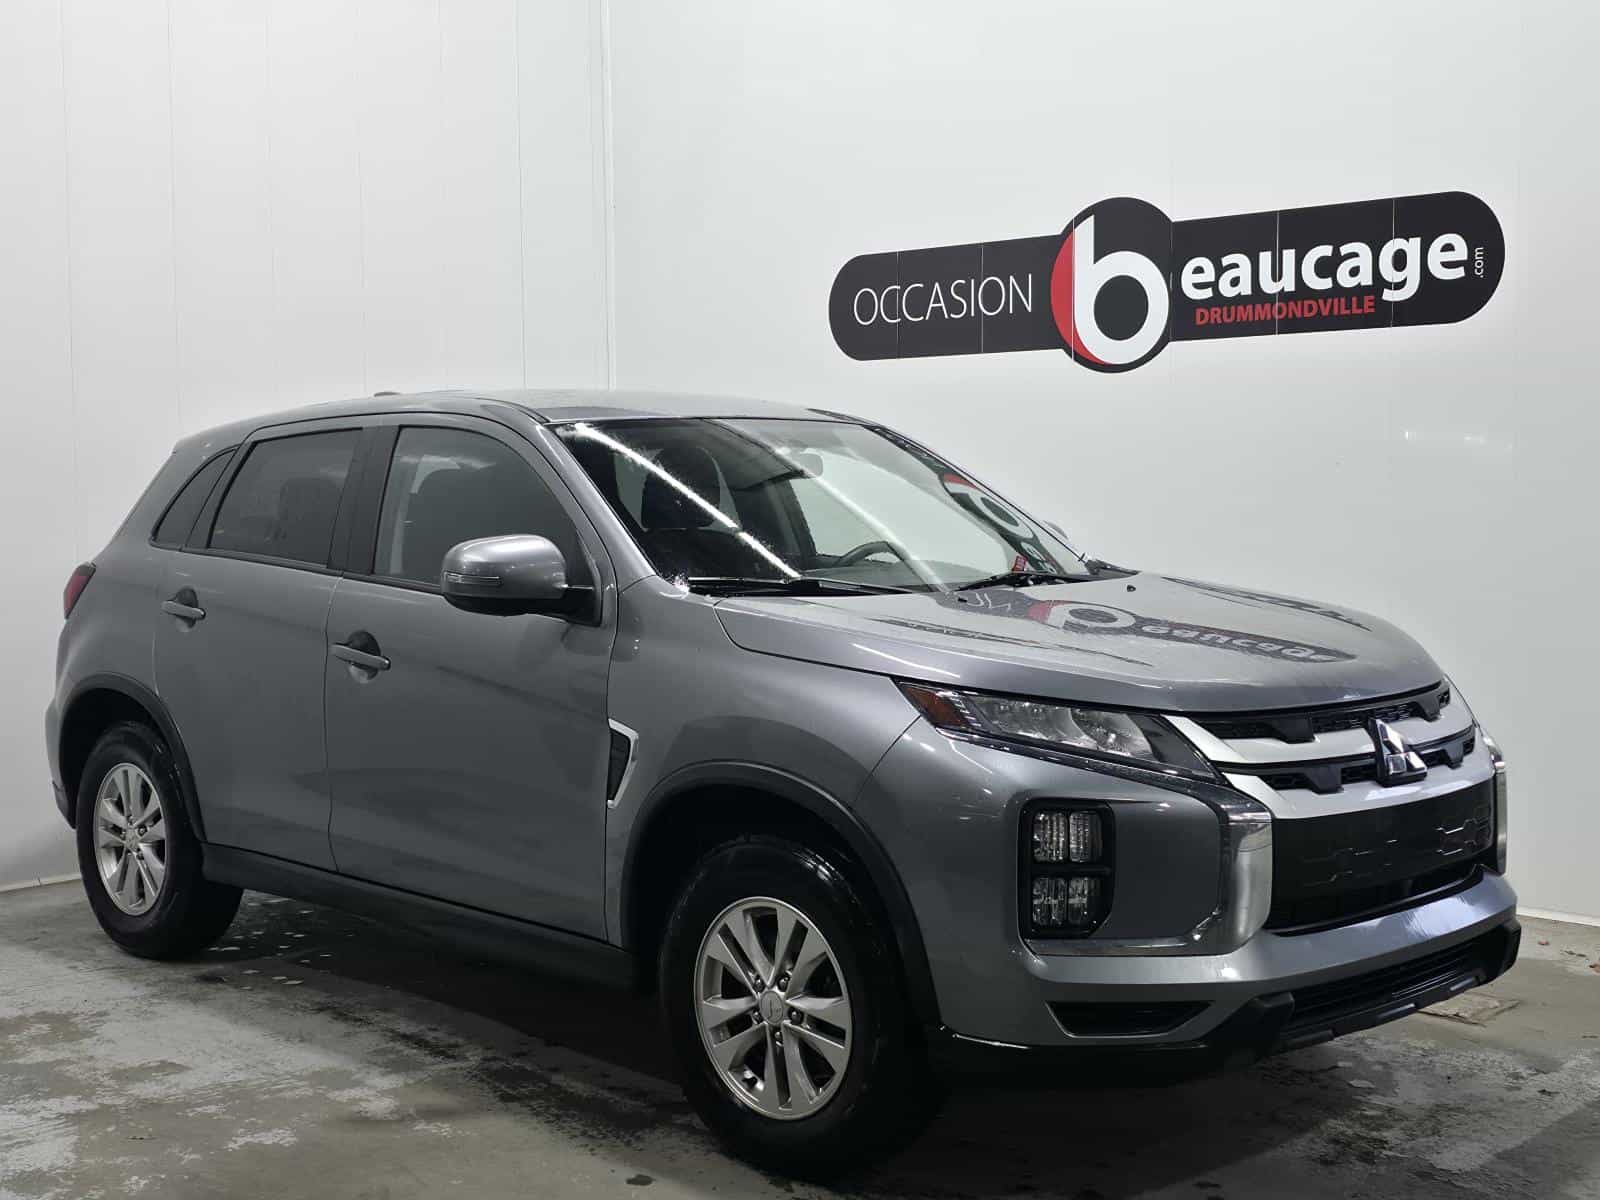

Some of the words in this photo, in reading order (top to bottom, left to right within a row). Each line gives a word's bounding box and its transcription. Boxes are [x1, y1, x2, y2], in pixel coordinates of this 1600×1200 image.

[1474, 246, 1484, 278] .com
[854, 273, 1032, 326] OCCASION
[1195, 295, 1376, 326] DRUMMONDVILLE
